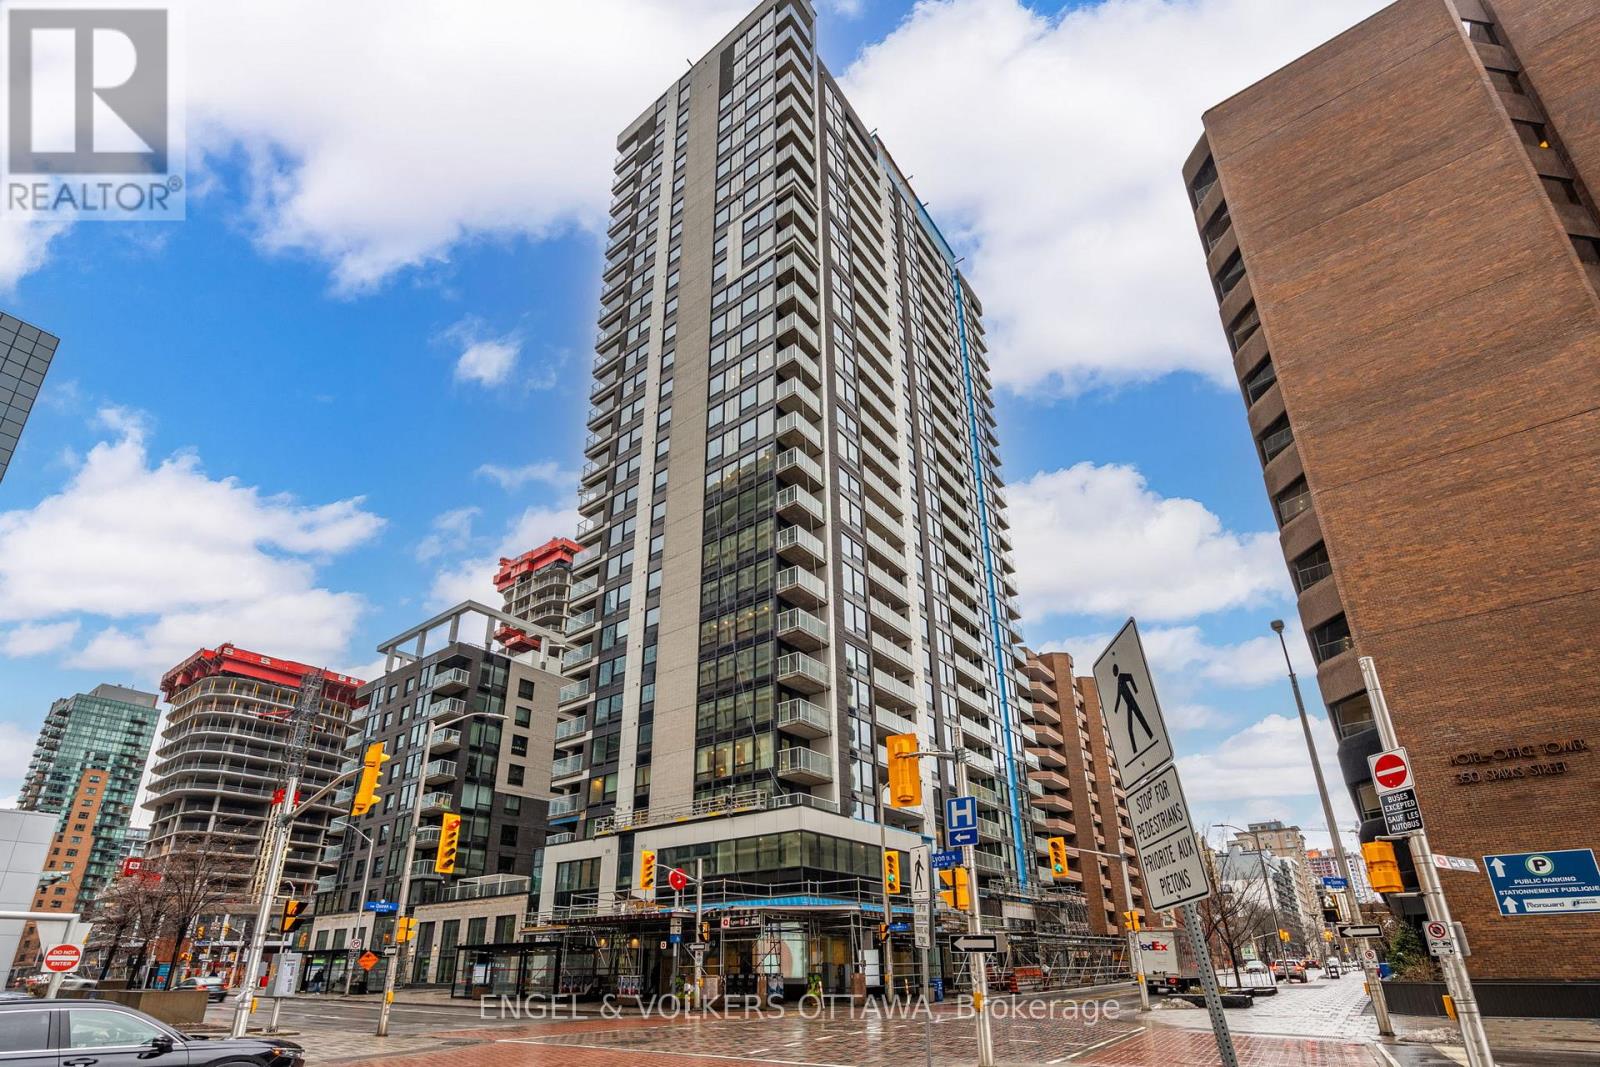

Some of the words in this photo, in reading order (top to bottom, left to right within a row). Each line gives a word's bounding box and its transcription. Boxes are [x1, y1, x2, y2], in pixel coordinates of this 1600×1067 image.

[1456, 771, 1480, 784] 350
[1485, 766, 1525, 780] SPARKS
[1529, 761, 1568, 776] STREET
[1136, 787, 1152, 815] STOP
[1154, 780, 1170, 802] FOR
[1387, 792, 1409, 803] BUSES
[1384, 799, 1416, 812] EXCEPTED
[951, 799, 973, 828] H
[1387, 813, 1404, 824] SAUF
[1406, 810, 1419, 820] LES
[1136, 802, 1183, 842] PEDESTRIANS
[1391, 819, 1420, 832] AUTOBUS
[1143, 840, 1176, 873] PRIORITÉ
[1178, 835, 1195, 860] AUX
[1532, 859, 1547, 871] P
[1159, 868, 1192, 896] PIÉTONS
[1514, 877, 1542, 885] PUBLIC
[1542, 875, 1577, 883] PARKING
[1498, 887, 1560, 896] STATIONNEMENT
[1560, 885, 1600, 893] PUBLIQUE
[1140, 941, 1168, 951] edEx
